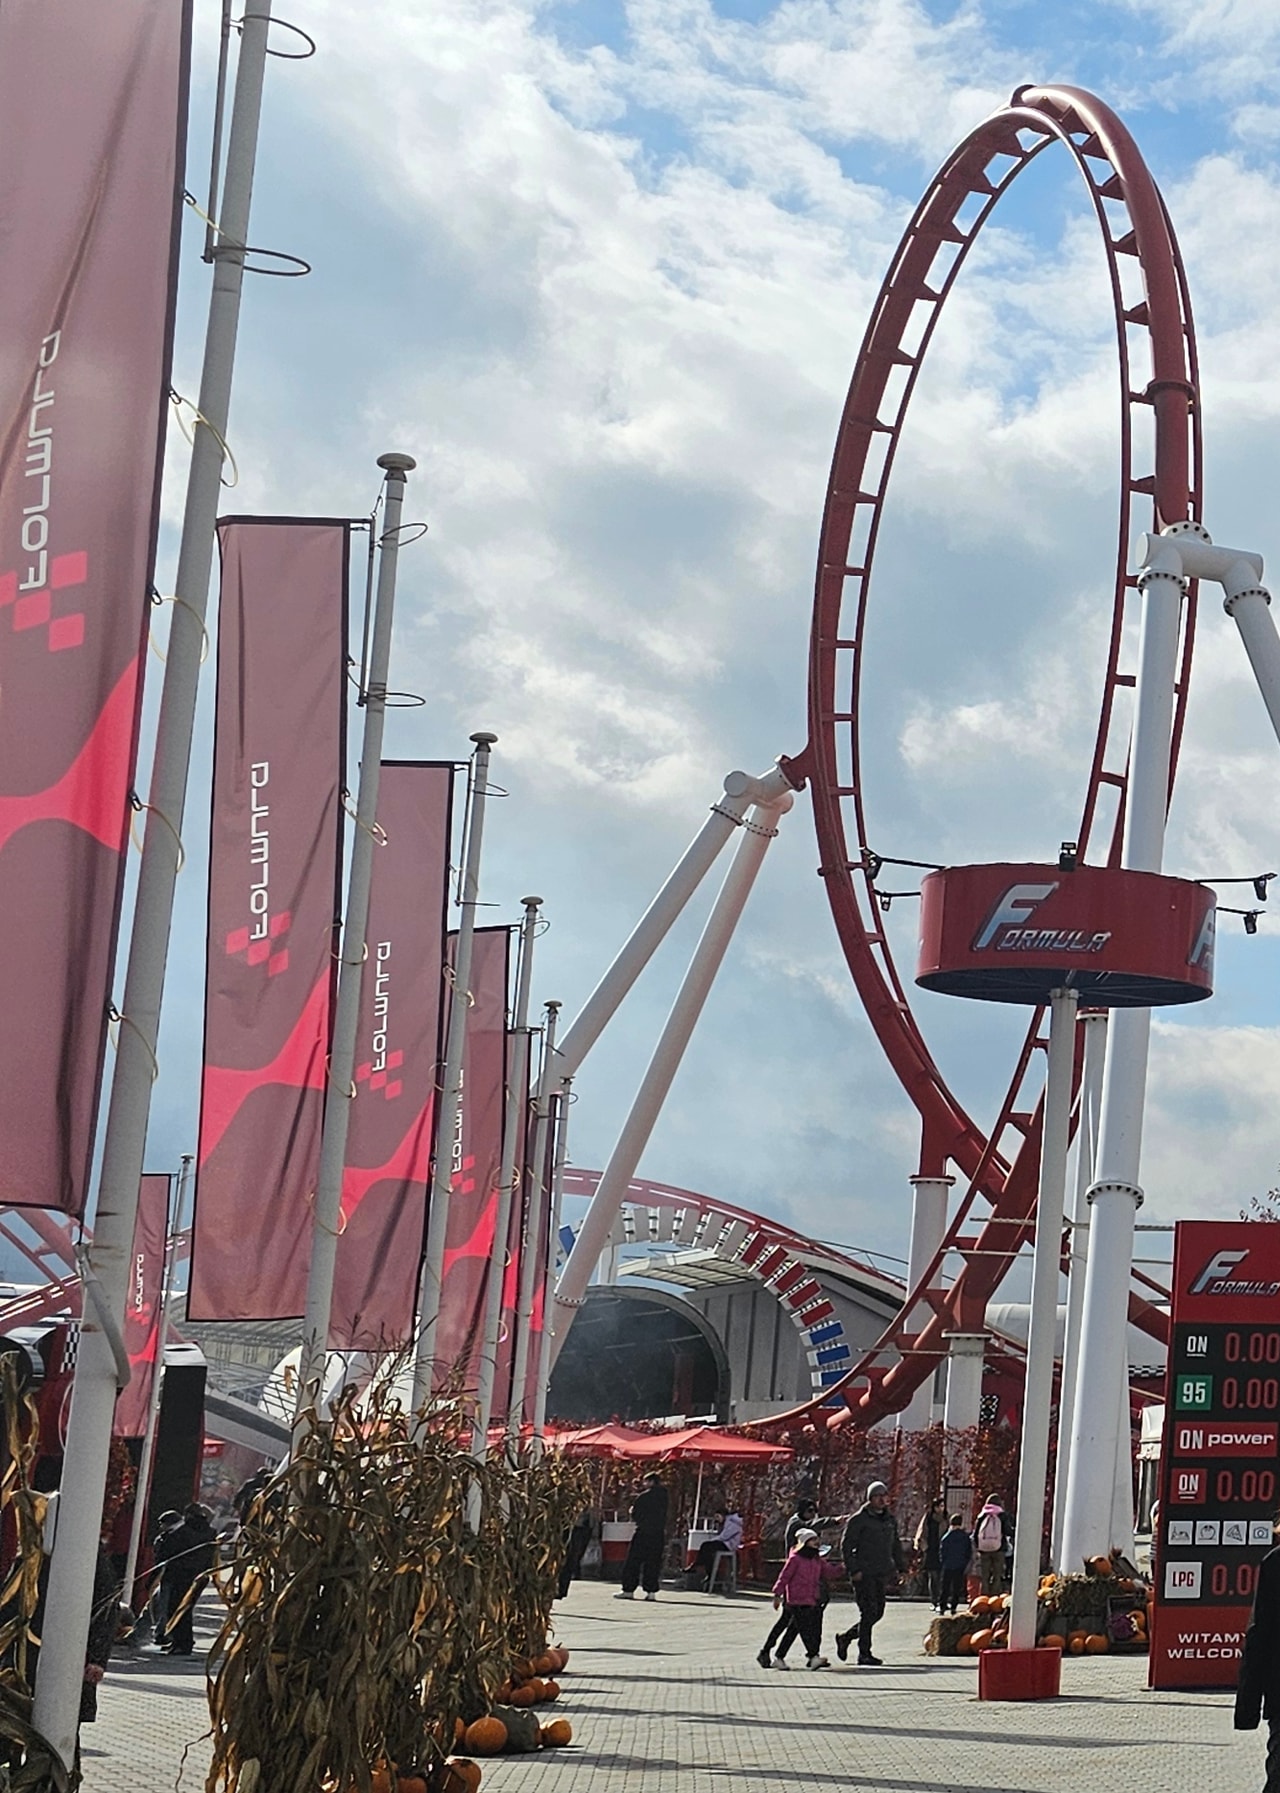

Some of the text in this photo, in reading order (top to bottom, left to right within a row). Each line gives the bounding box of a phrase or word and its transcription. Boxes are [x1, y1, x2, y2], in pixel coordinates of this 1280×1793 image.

[1187, 1332, 1280, 1363] ON 0.00
[1182, 1378, 1279, 1409] 95 0.00
[1180, 1430, 1274, 1449] ON power
[1178, 1470, 1275, 1502] ON 0.00
[1172, 1571, 1194, 1587] LPG
[1178, 1633, 1247, 1644] WITAM
[1168, 1649, 1243, 1659] WELCO
